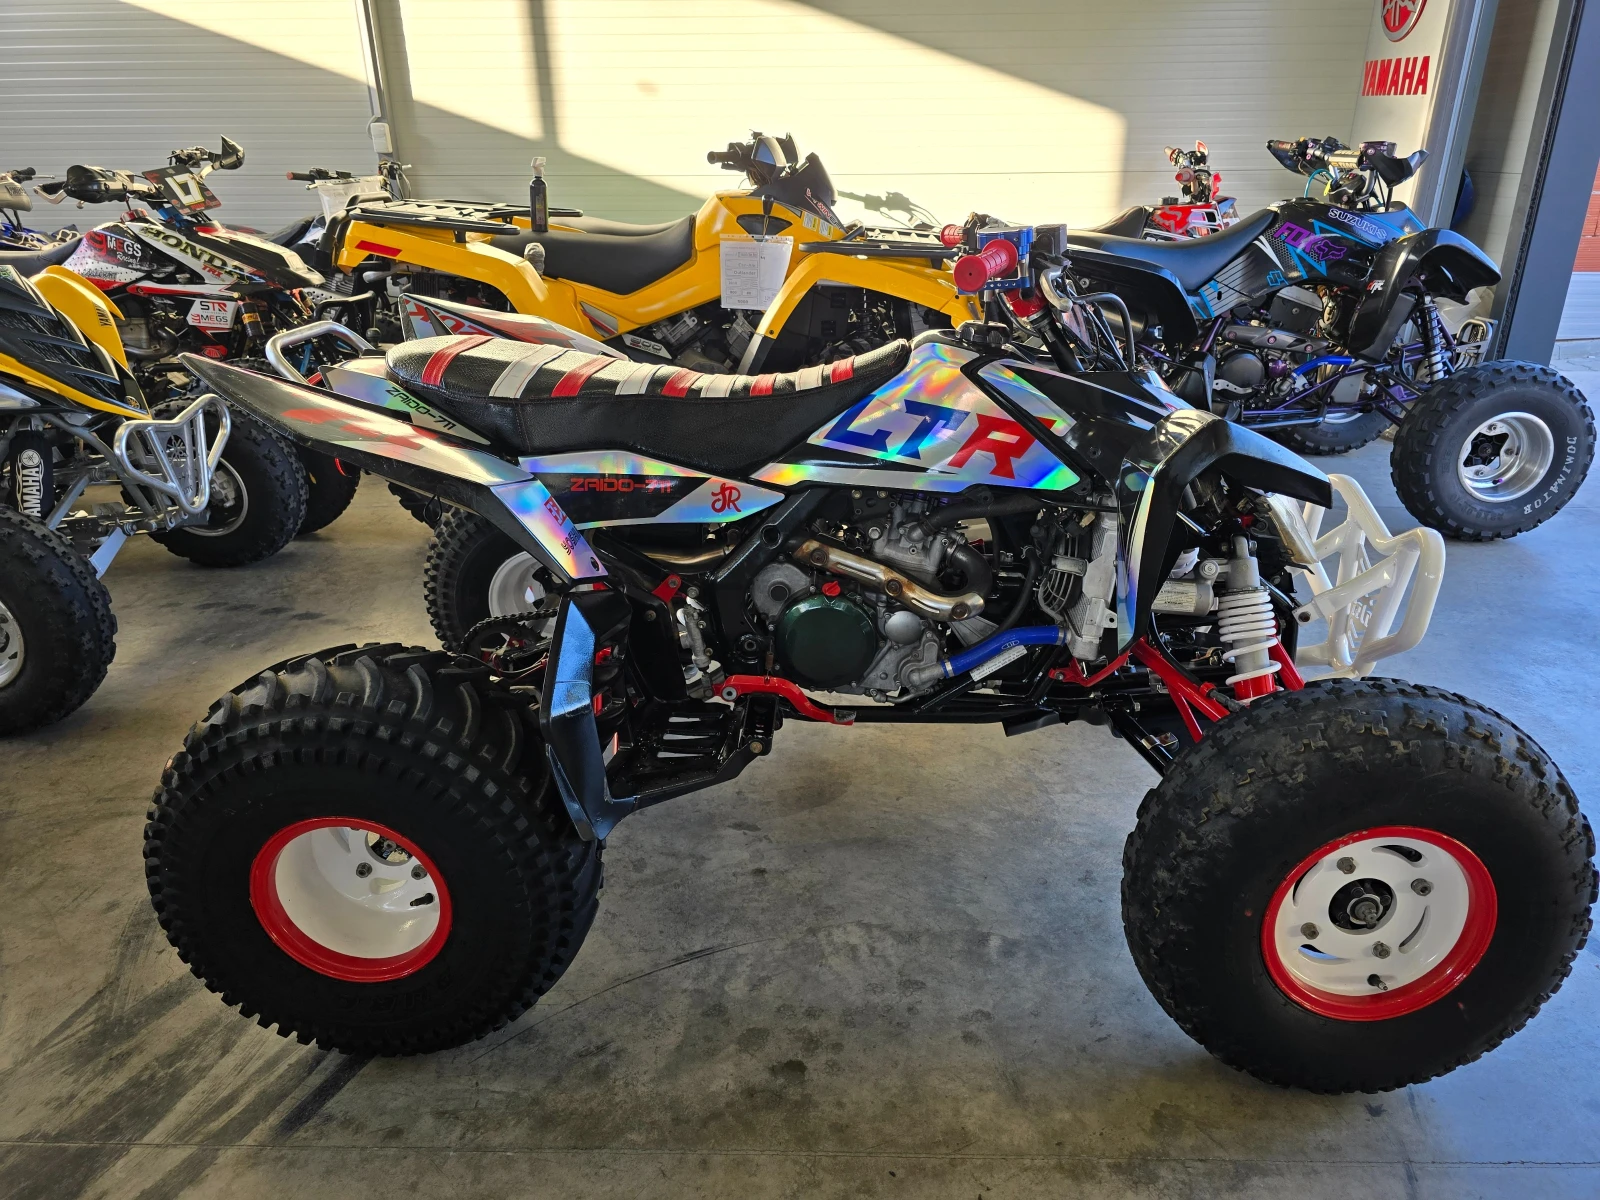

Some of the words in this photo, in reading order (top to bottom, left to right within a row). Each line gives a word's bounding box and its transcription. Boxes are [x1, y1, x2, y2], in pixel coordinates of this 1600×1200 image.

[1361, 56, 1431, 96] YAMAHA
[107, 235, 142, 258] MEGS
[138, 225, 250, 285] HONDA
[1272, 221, 1325, 254] FOX
[202, 264, 224, 279] TRX
[200, 314, 228, 323] MEGS
[385, 386, 457, 431] ZAIDO-711
[22, 467, 42, 517] AMAHA
[570, 477, 672, 494] ZAIDO-711
[1523, 436, 1578, 515] DOMINATOR
